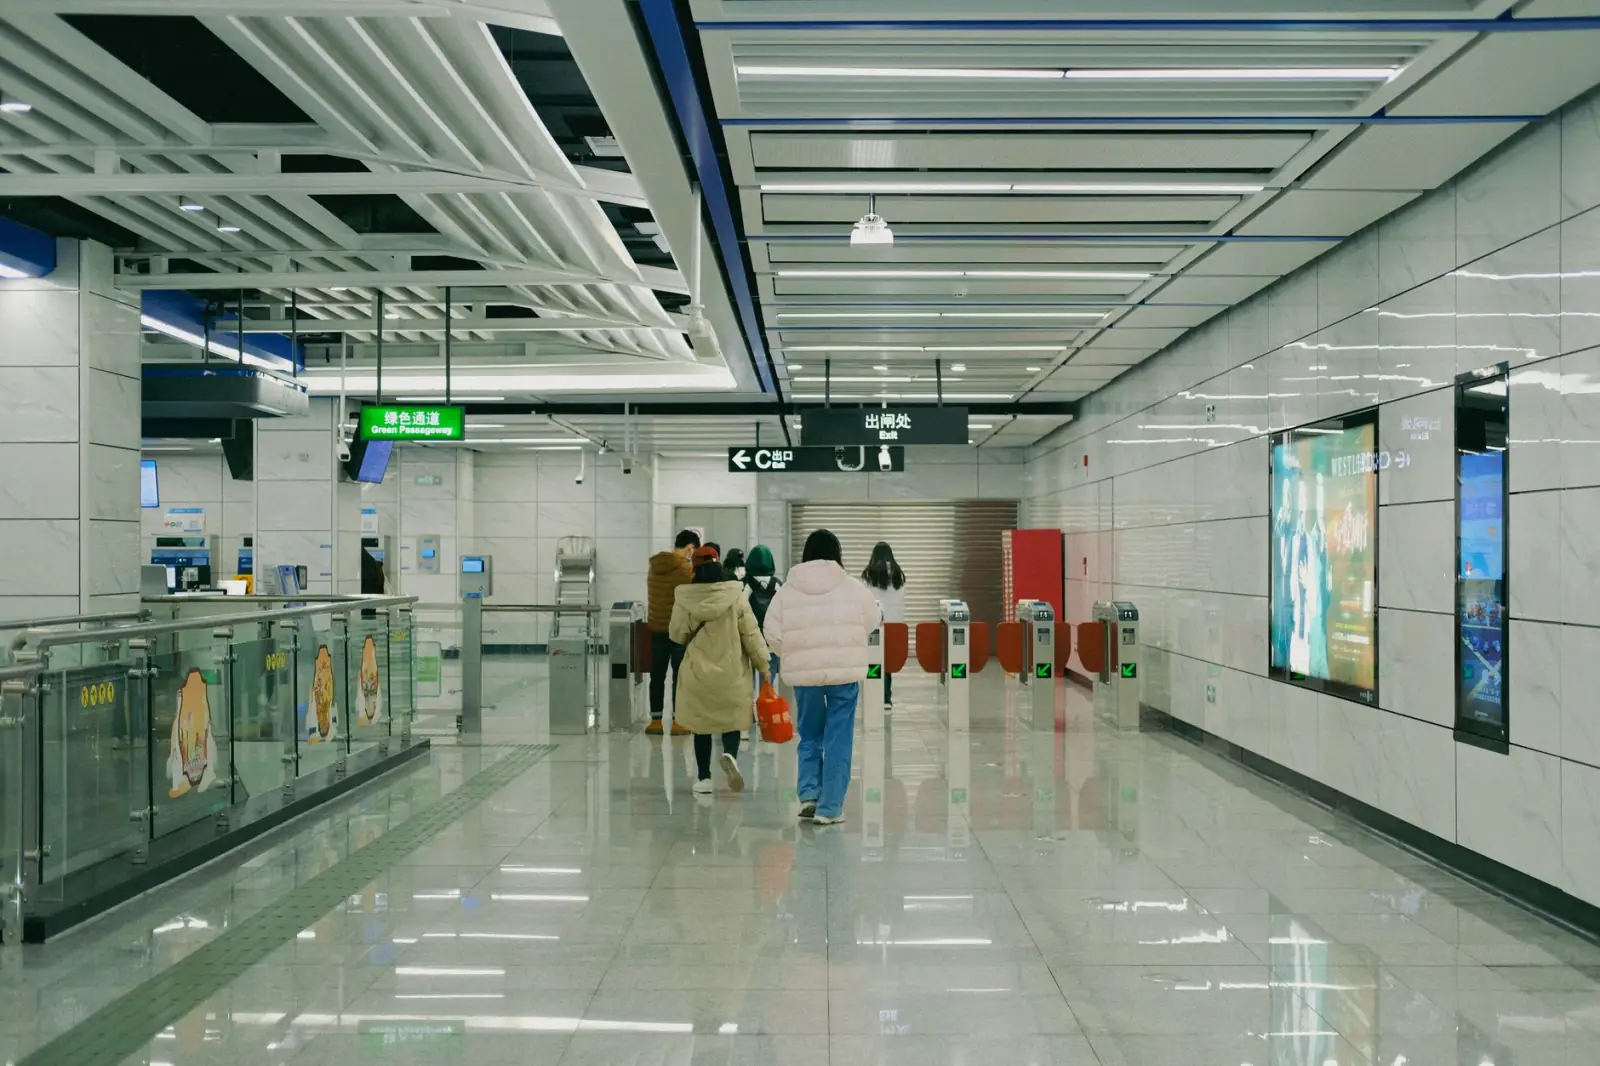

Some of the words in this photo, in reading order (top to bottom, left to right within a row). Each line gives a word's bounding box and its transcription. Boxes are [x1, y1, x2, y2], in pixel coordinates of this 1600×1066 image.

[384, 411, 440, 425] 绿色通道
[865, 413, 911, 429] 出闸处
[371, 425, 397, 434] Green
[879, 430, 898, 440] Exit
